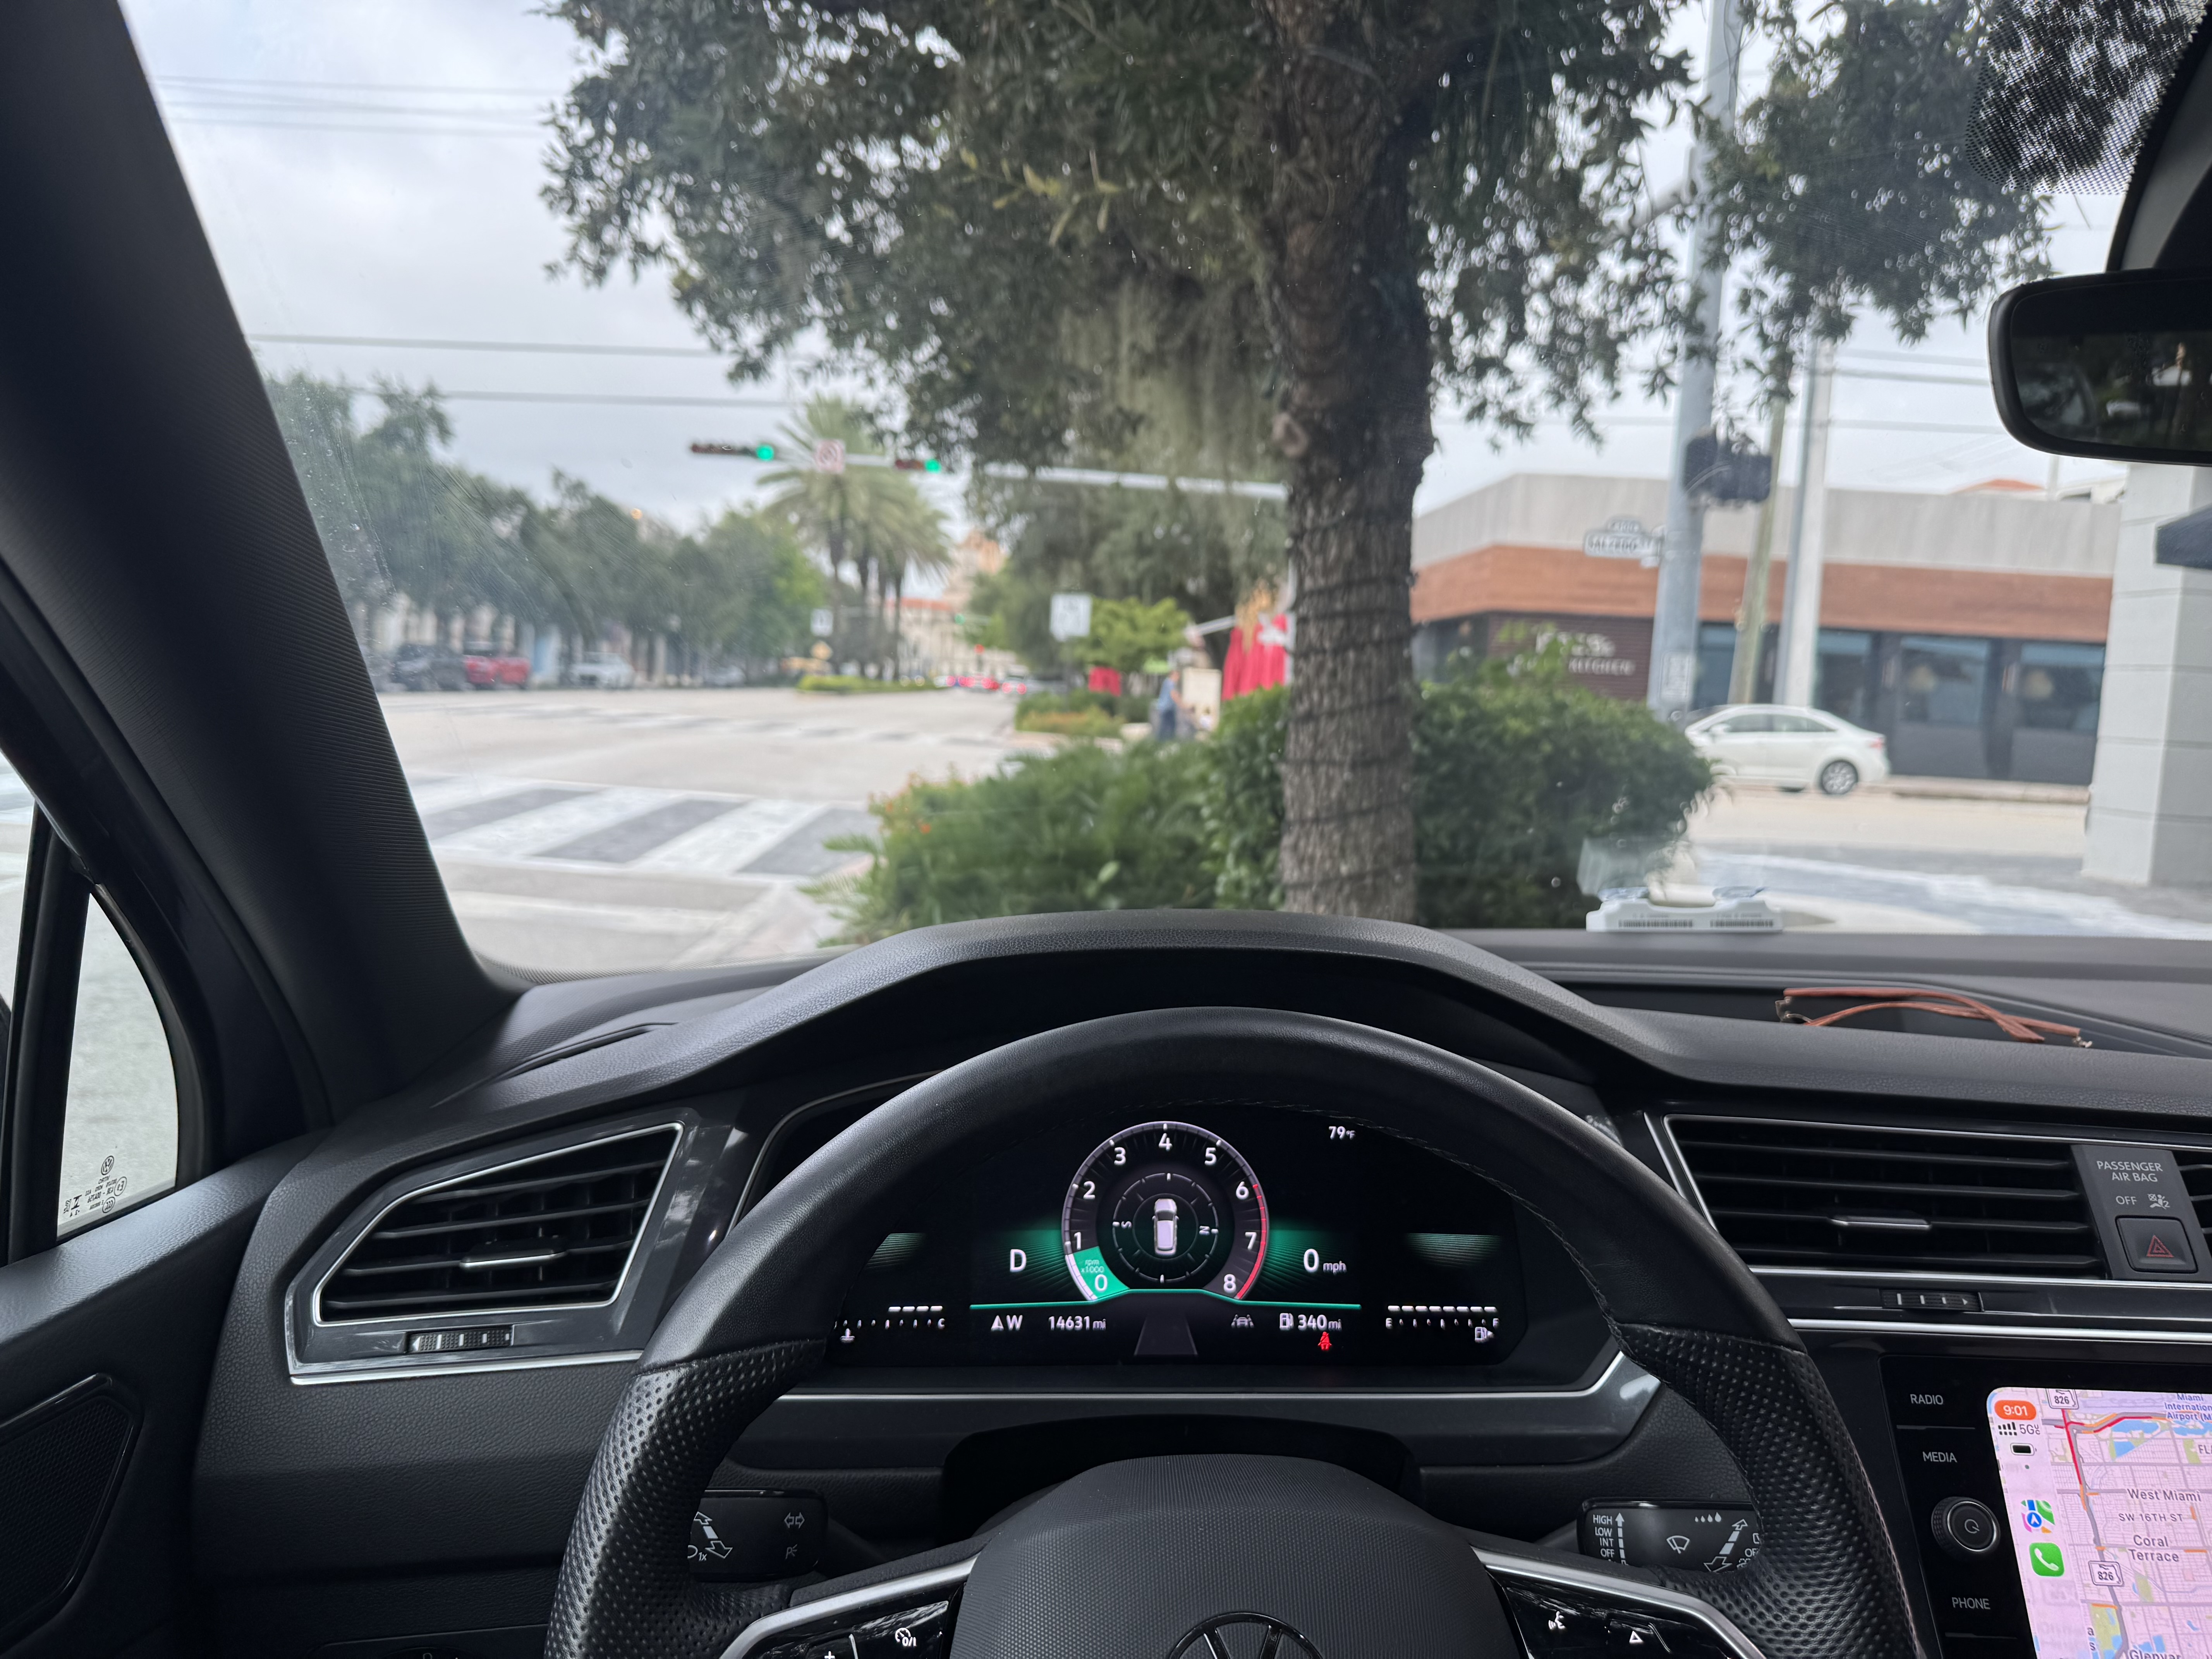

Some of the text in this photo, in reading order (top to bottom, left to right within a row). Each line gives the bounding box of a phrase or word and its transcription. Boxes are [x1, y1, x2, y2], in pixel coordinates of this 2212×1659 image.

[1159, 1133, 1172, 1151] 4
[1114, 1147, 1126, 1165] 3
[1204, 1147, 1217, 1165] 5
[2097, 1161, 2163, 1171] PASSENGER
[2112, 1172, 2158, 1182] AIR BAG
[1083, 1181, 1096, 1199] 2
[1236, 1181, 1249, 1199] 6
[2116, 1195, 2137, 1205] OFF
[1074, 1232, 1081, 1250] 1
[1245, 1231, 1257, 1250] 7
[1010, 1249, 1027, 1272] D
[1303, 1249, 1346, 1274] 0 mph
[1095, 1274, 1108, 1292] 0
[1223, 1274, 1237, 1293] 8
[1049, 1316, 1106, 1330] 14631 mi
[1298, 1314, 1342, 1330] 340 mi
[1910, 1394, 1944, 1405] RADIO
[2054, 1396, 2069, 1405] 826
[2177, 1393, 2203, 1401] Miami
[2003, 1405, 2028, 1416] 9:01
[2167, 1412, 2198, 1421] Airport
[2198, 1444, 2212, 1454] FL
[1922, 1451, 1958, 1463] MEDIA
[2127, 1488, 2202, 1502] West Miami
[1593, 1514, 1612, 1525] HIGH
[2118, 1513, 2183, 1522] SW 16TH ST
[1595, 1526, 1612, 1537] LOW
[1600, 1537, 1614, 1547] INT
[2133, 1534, 2169, 1547] Coral
[1600, 1548, 1615, 1558] OFF
[2128, 1549, 2179, 1562] Terrace
[2097, 1570, 2114, 1581] 826
[1952, 1597, 1990, 1610] PHONE
